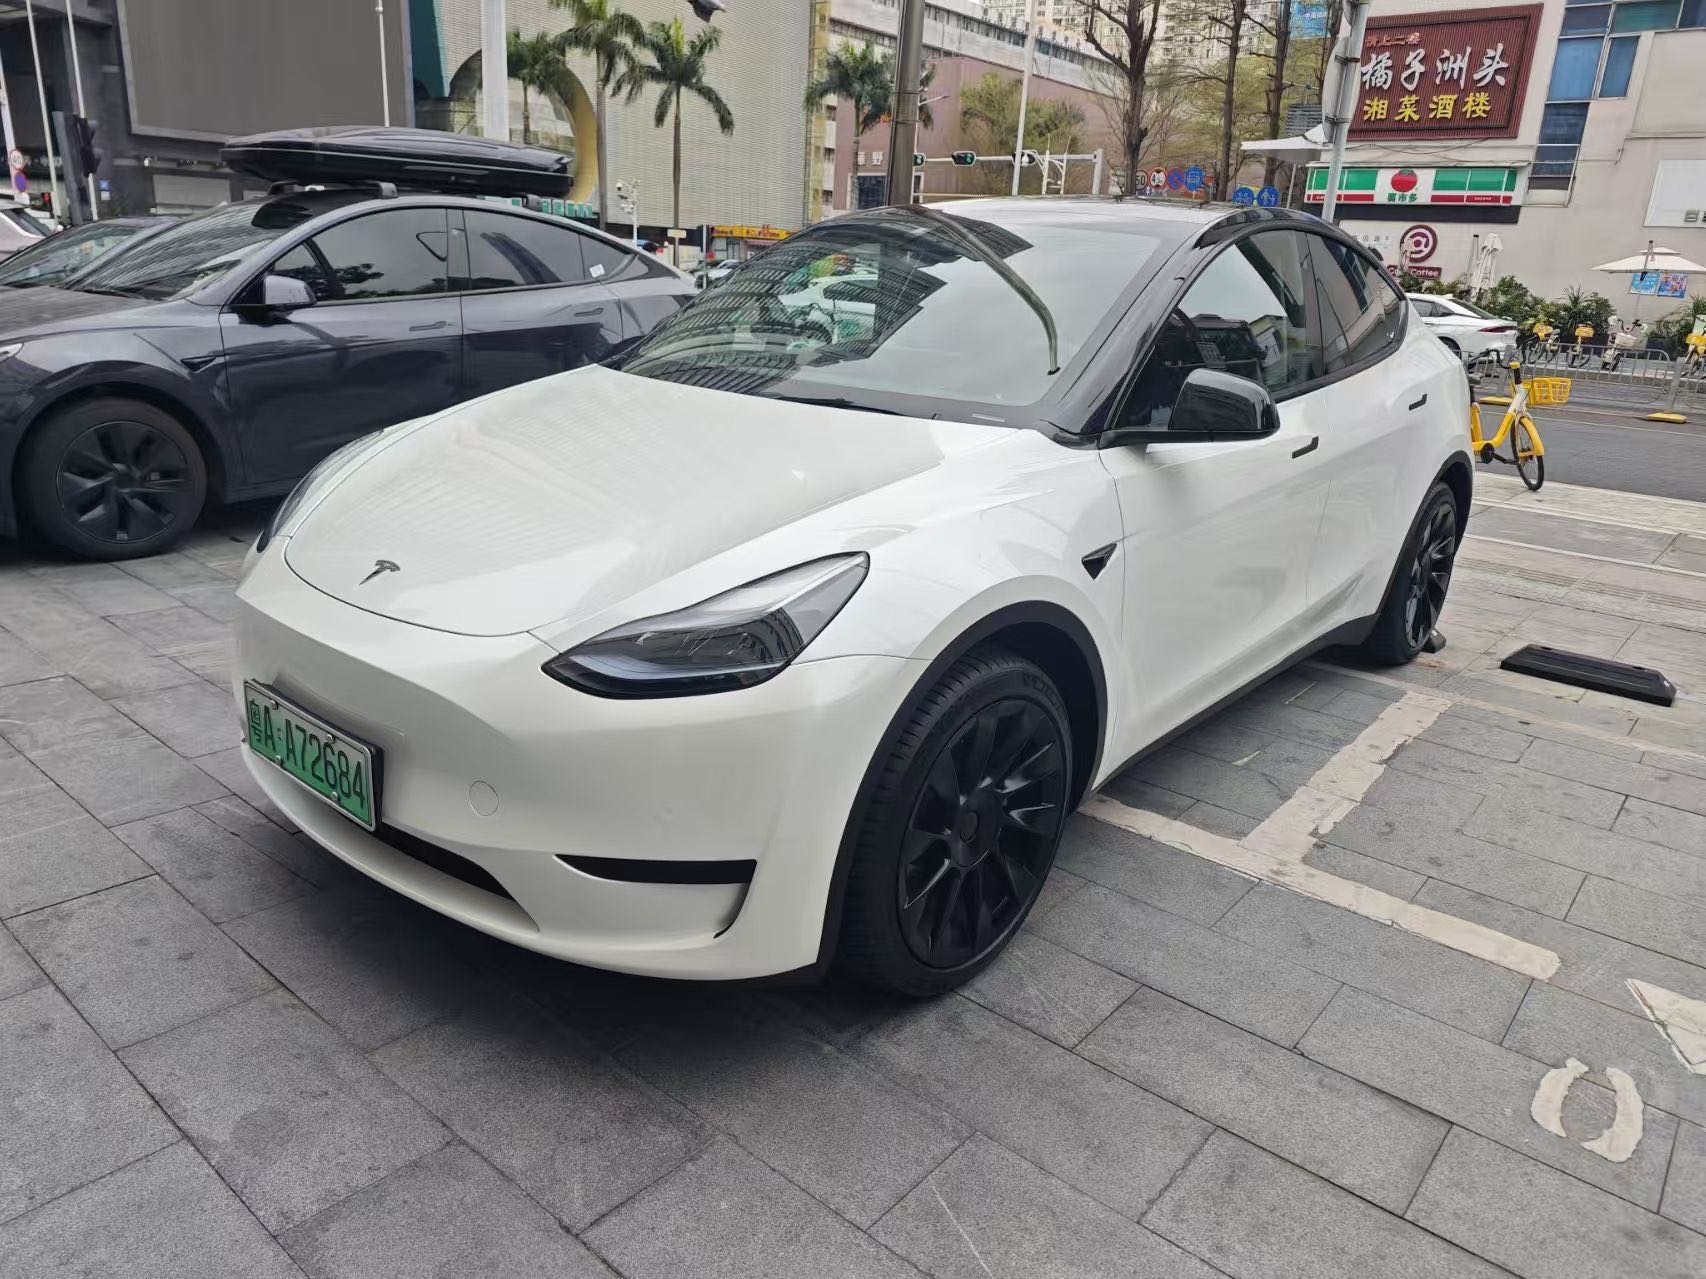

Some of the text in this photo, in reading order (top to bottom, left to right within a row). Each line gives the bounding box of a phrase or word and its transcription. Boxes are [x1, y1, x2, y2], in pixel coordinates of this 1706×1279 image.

[1361, 43, 1508, 91] 橘子洲头
[1364, 92, 1491, 122] 湘菜酒楼
[1410, 268, 1439, 277] Coffee
